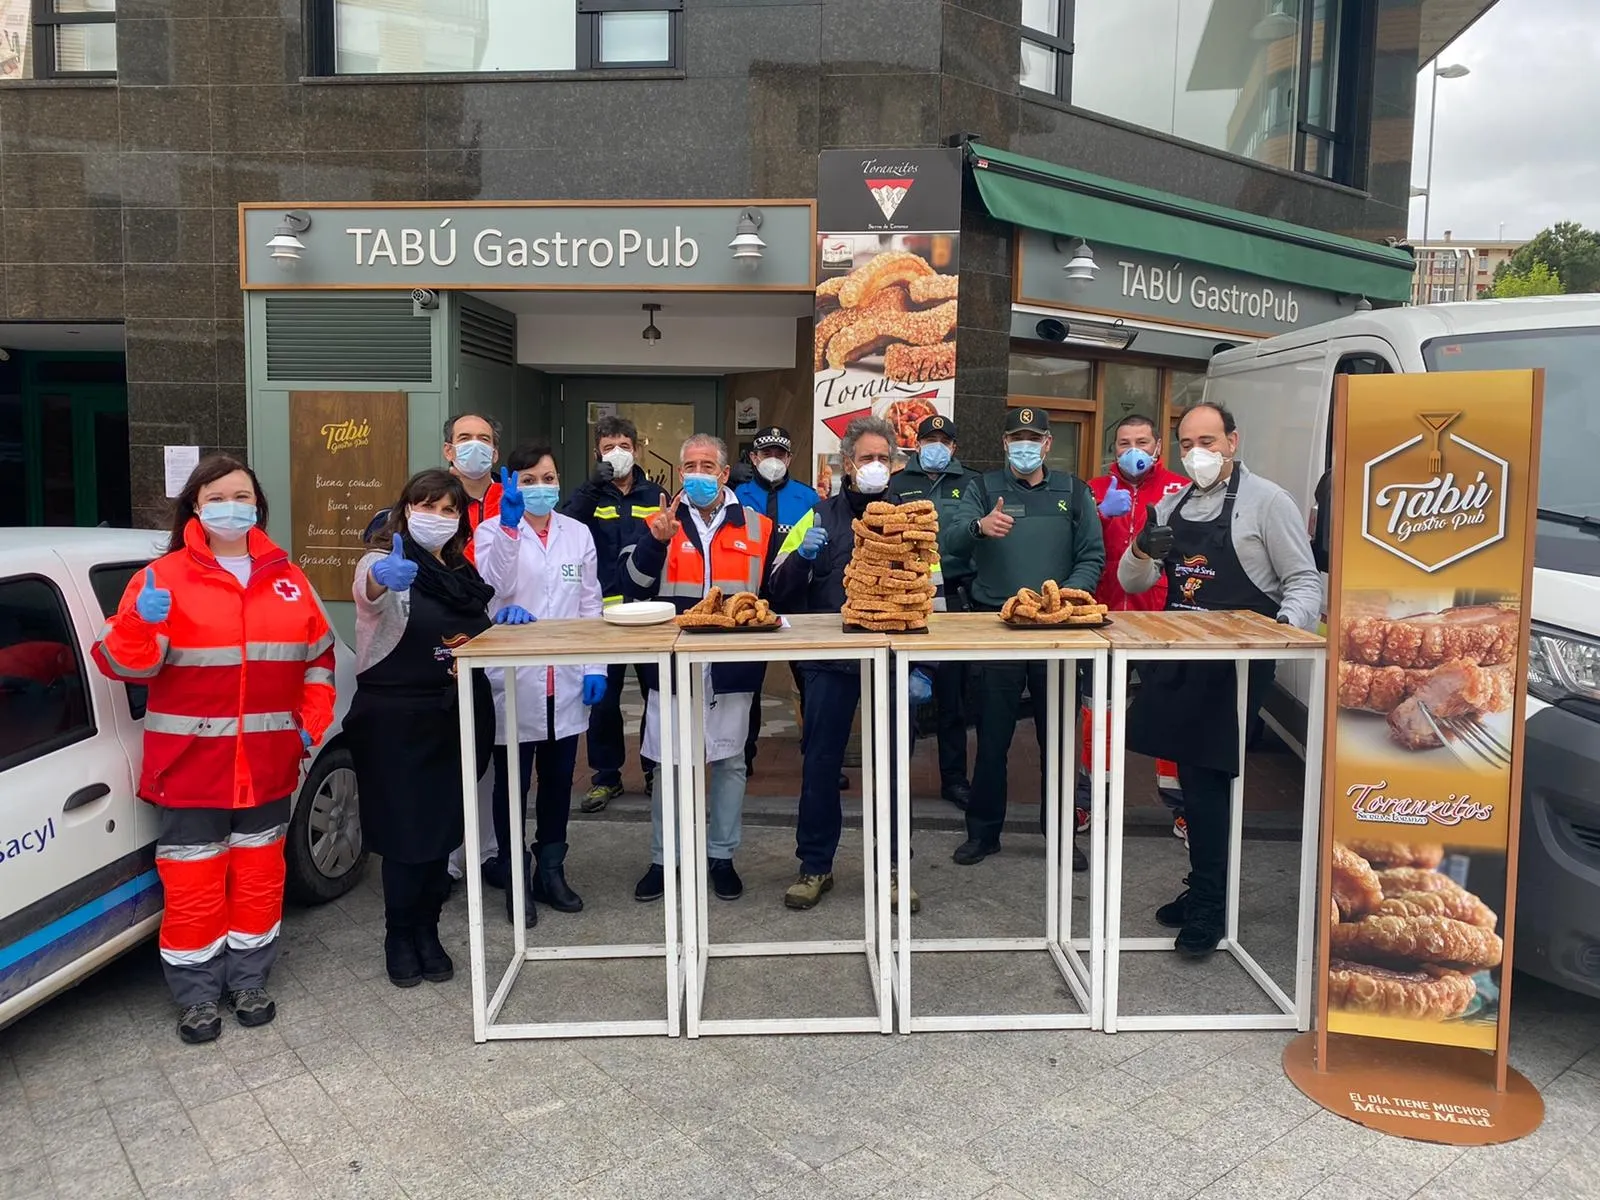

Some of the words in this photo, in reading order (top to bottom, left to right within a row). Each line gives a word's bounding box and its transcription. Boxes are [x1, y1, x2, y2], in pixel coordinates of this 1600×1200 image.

[861, 158, 920, 177] Toranzitos
[346, 217, 457, 267] TABÚ
[473, 226, 700, 268] GastroPub
[1118, 261, 1183, 304] TABÚ
[1190, 275, 1299, 323] GastroPub
[815, 358, 951, 407] Toranzitos
[320, 418, 372, 450] Tabú
[315, 474, 344, 489] Buena
[348, 477, 383, 488] comida
[327, 500, 349, 511] Buen
[354, 503, 374, 511] vino
[1376, 471, 1493, 534] Tabú
[307, 524, 336, 537] Buena
[340, 527, 364, 539] comp
[1397, 516, 1448, 542] Gastro
[1452, 508, 1486, 530] Pub
[298, 553, 342, 569] Grandes
[1346, 780, 1493, 826] Toranzitos
[1349, 1092, 1366, 1102] EL
[1368, 1093, 1391, 1105] DÍA
[1392, 1097, 1431, 1110] TIENE
[1432, 1102, 1490, 1118] MUCHOS
[1352, 1102, 1431, 1120] Minute
